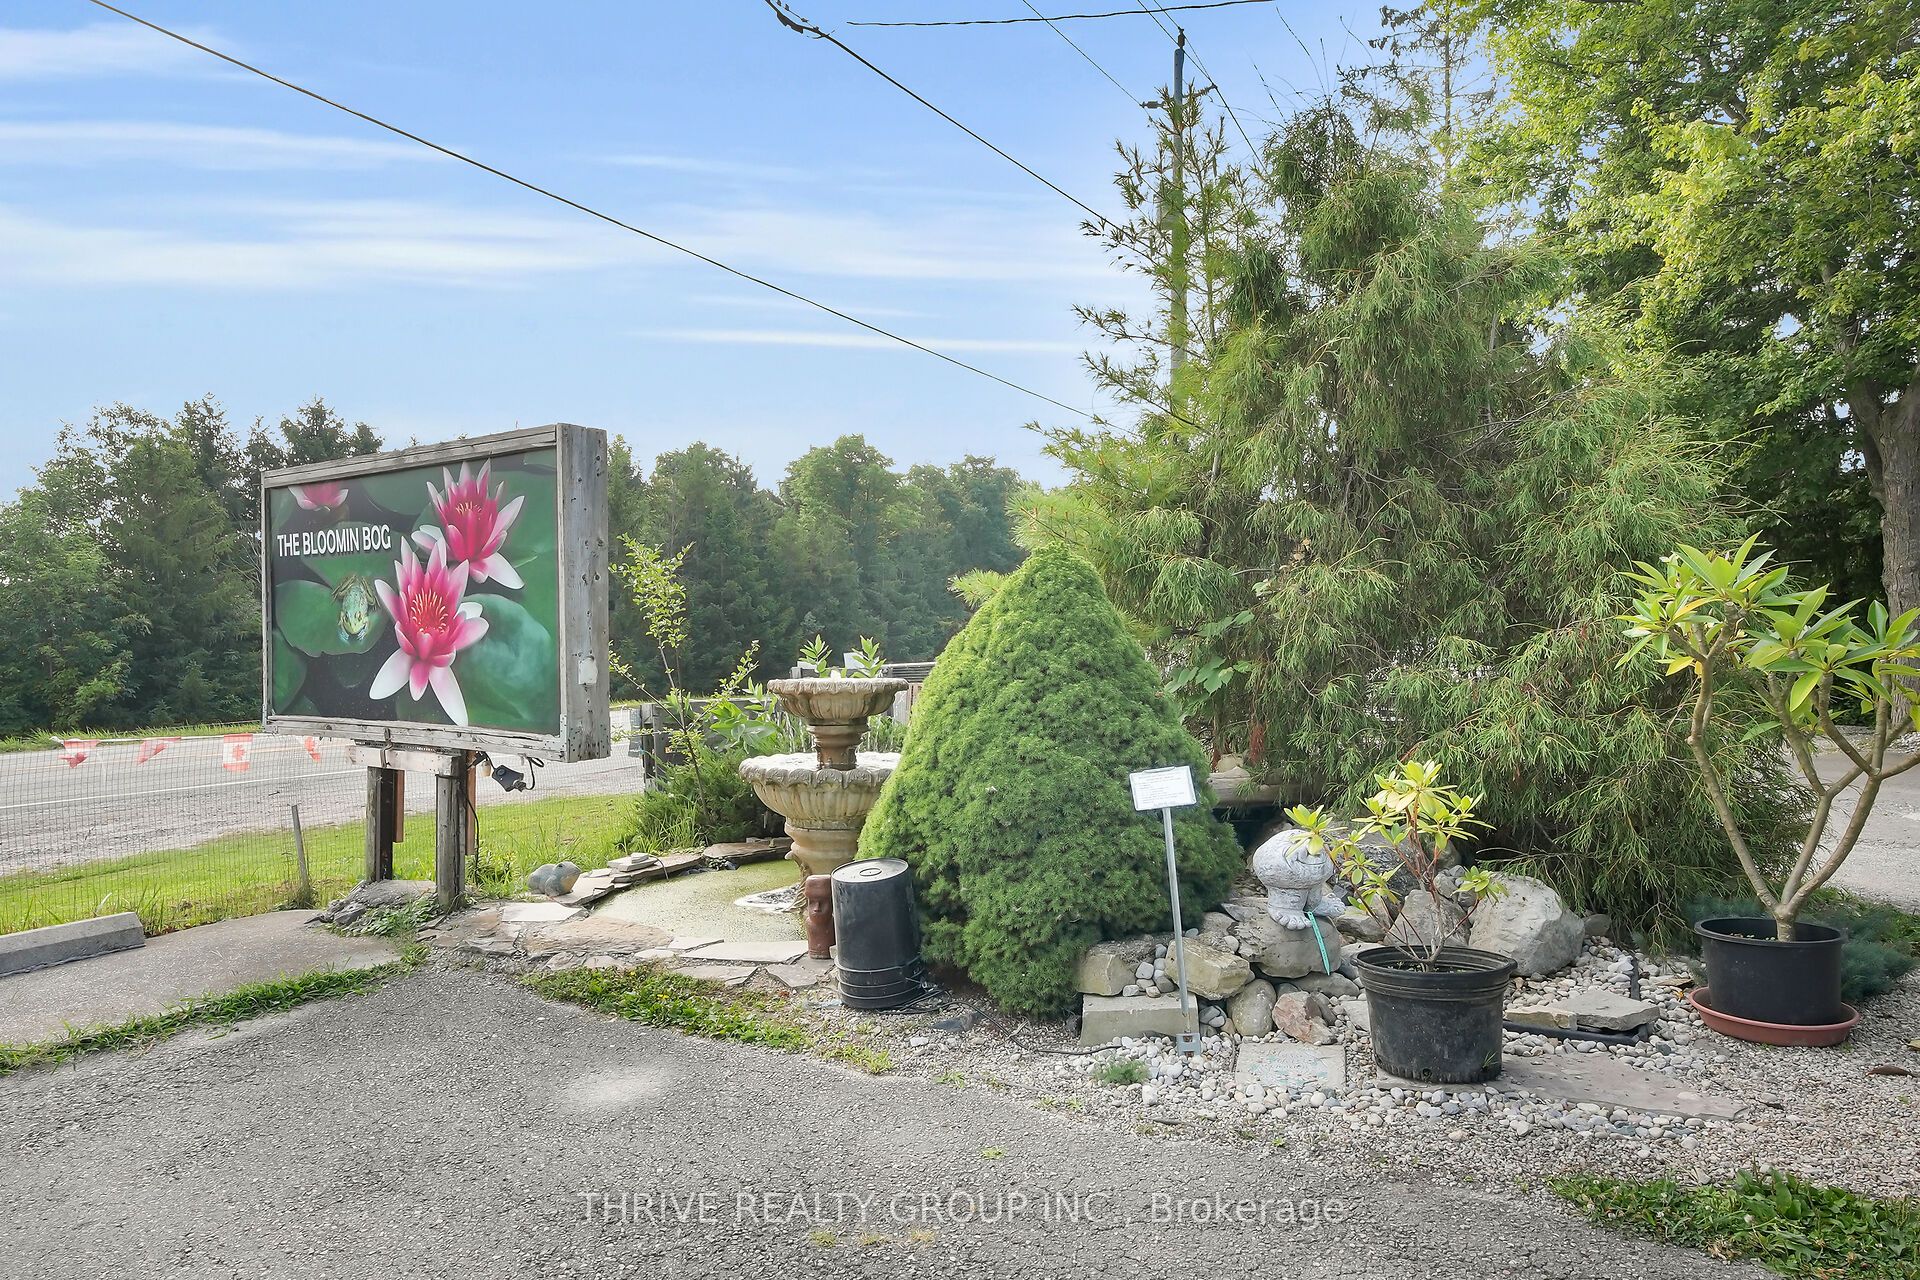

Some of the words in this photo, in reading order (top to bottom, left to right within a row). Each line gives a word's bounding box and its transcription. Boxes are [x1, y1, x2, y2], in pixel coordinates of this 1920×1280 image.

[276, 534, 300, 557] THE
[302, 527, 359, 555] BLOOMIN
[362, 524, 391, 550] BOG
